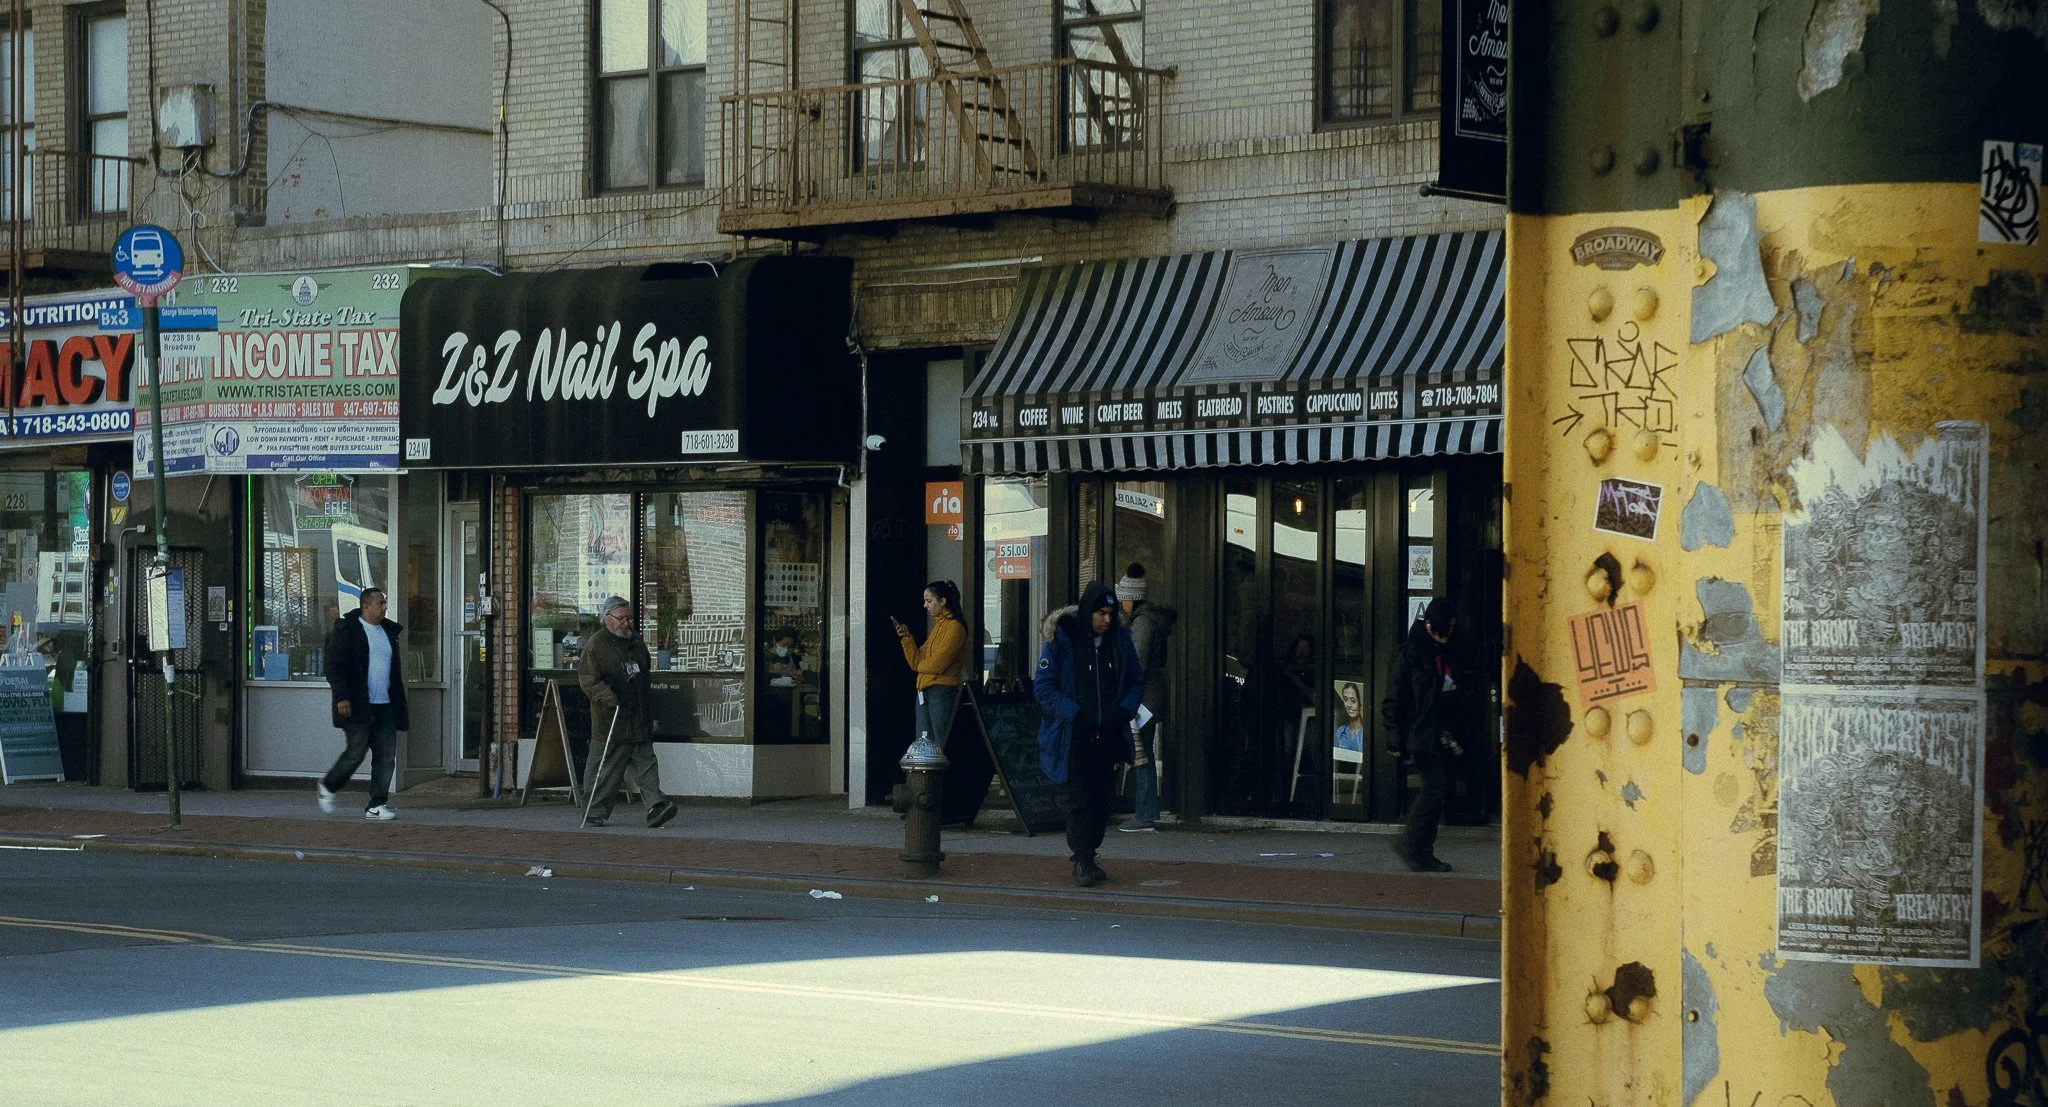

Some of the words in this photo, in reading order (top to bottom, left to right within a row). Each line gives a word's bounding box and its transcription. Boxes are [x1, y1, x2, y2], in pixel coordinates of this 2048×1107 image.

[1573, 236, 1660, 260] BROADWAY
[120, 275, 133, 289] NO
[135, 275, 177, 294] STANDING
[211, 276, 239, 295] 232
[371, 273, 400, 291] 232
[101, 309, 129, 326] Bx3
[161, 308, 177, 317] George
[178, 307, 202, 317] Washington
[202, 307, 217, 317] Bridge
[240, 307, 332, 328] Tri-State
[337, 306, 376, 326] Tax
[1229, 301, 1296, 331] Amour
[163, 343, 197, 352] Broadway
[213, 332, 332, 379] INCOME
[339, 331, 398, 377] TAX
[432, 329, 521, 407] Z&Z
[526, 320, 621, 402] Nail
[627, 322, 712, 418] Spa
[217, 383, 396, 399] WWW.TRISTATETAXES.COM
[208, 402, 240, 418] BUSINESS
[240, 402, 253, 418] TAX
[274, 402, 297, 417] AUDITS
[302, 402, 322, 417] SALES
[322, 402, 335, 417] TAX
[1019, 408, 1048, 427] COFFEE
[1061, 406, 1084, 425] WINE
[1097, 404, 1122, 423] CRAFT
[1123, 402, 1143, 421] BEER
[1157, 400, 1183, 419] MELTS
[1197, 397, 1242, 417] FLATBREAD
[1257, 396, 1294, 414] PASTRIES
[1306, 393, 1362, 413] CAPPUCCINO
[1370, 390, 1398, 410] LATTES
[1435, 384, 1499, 406] 718-708-7804
[22, 411, 130, 435] 718-543-0800
[972, 411, 988, 429] 234
[408, 442, 420, 457] 234
[685, 432, 735, 451] 718-601-3298
[313, 473, 337, 485] OPEN
[6, 494, 25, 510] 228
[932, 488, 961, 514] ria
[948, 525, 958, 535] ria
[999, 560, 1014, 574] ria
[1784, 619, 1808, 648] THE
[1811, 619, 1860, 648] BRONX
[1901, 621, 1977, 649] BREWERY
[1779, 886, 1804, 914] THE
[1808, 886, 1854, 917] BRONX
[1896, 893, 1972, 921] BREWERY
[1831, 932, 1848, 940] THE
